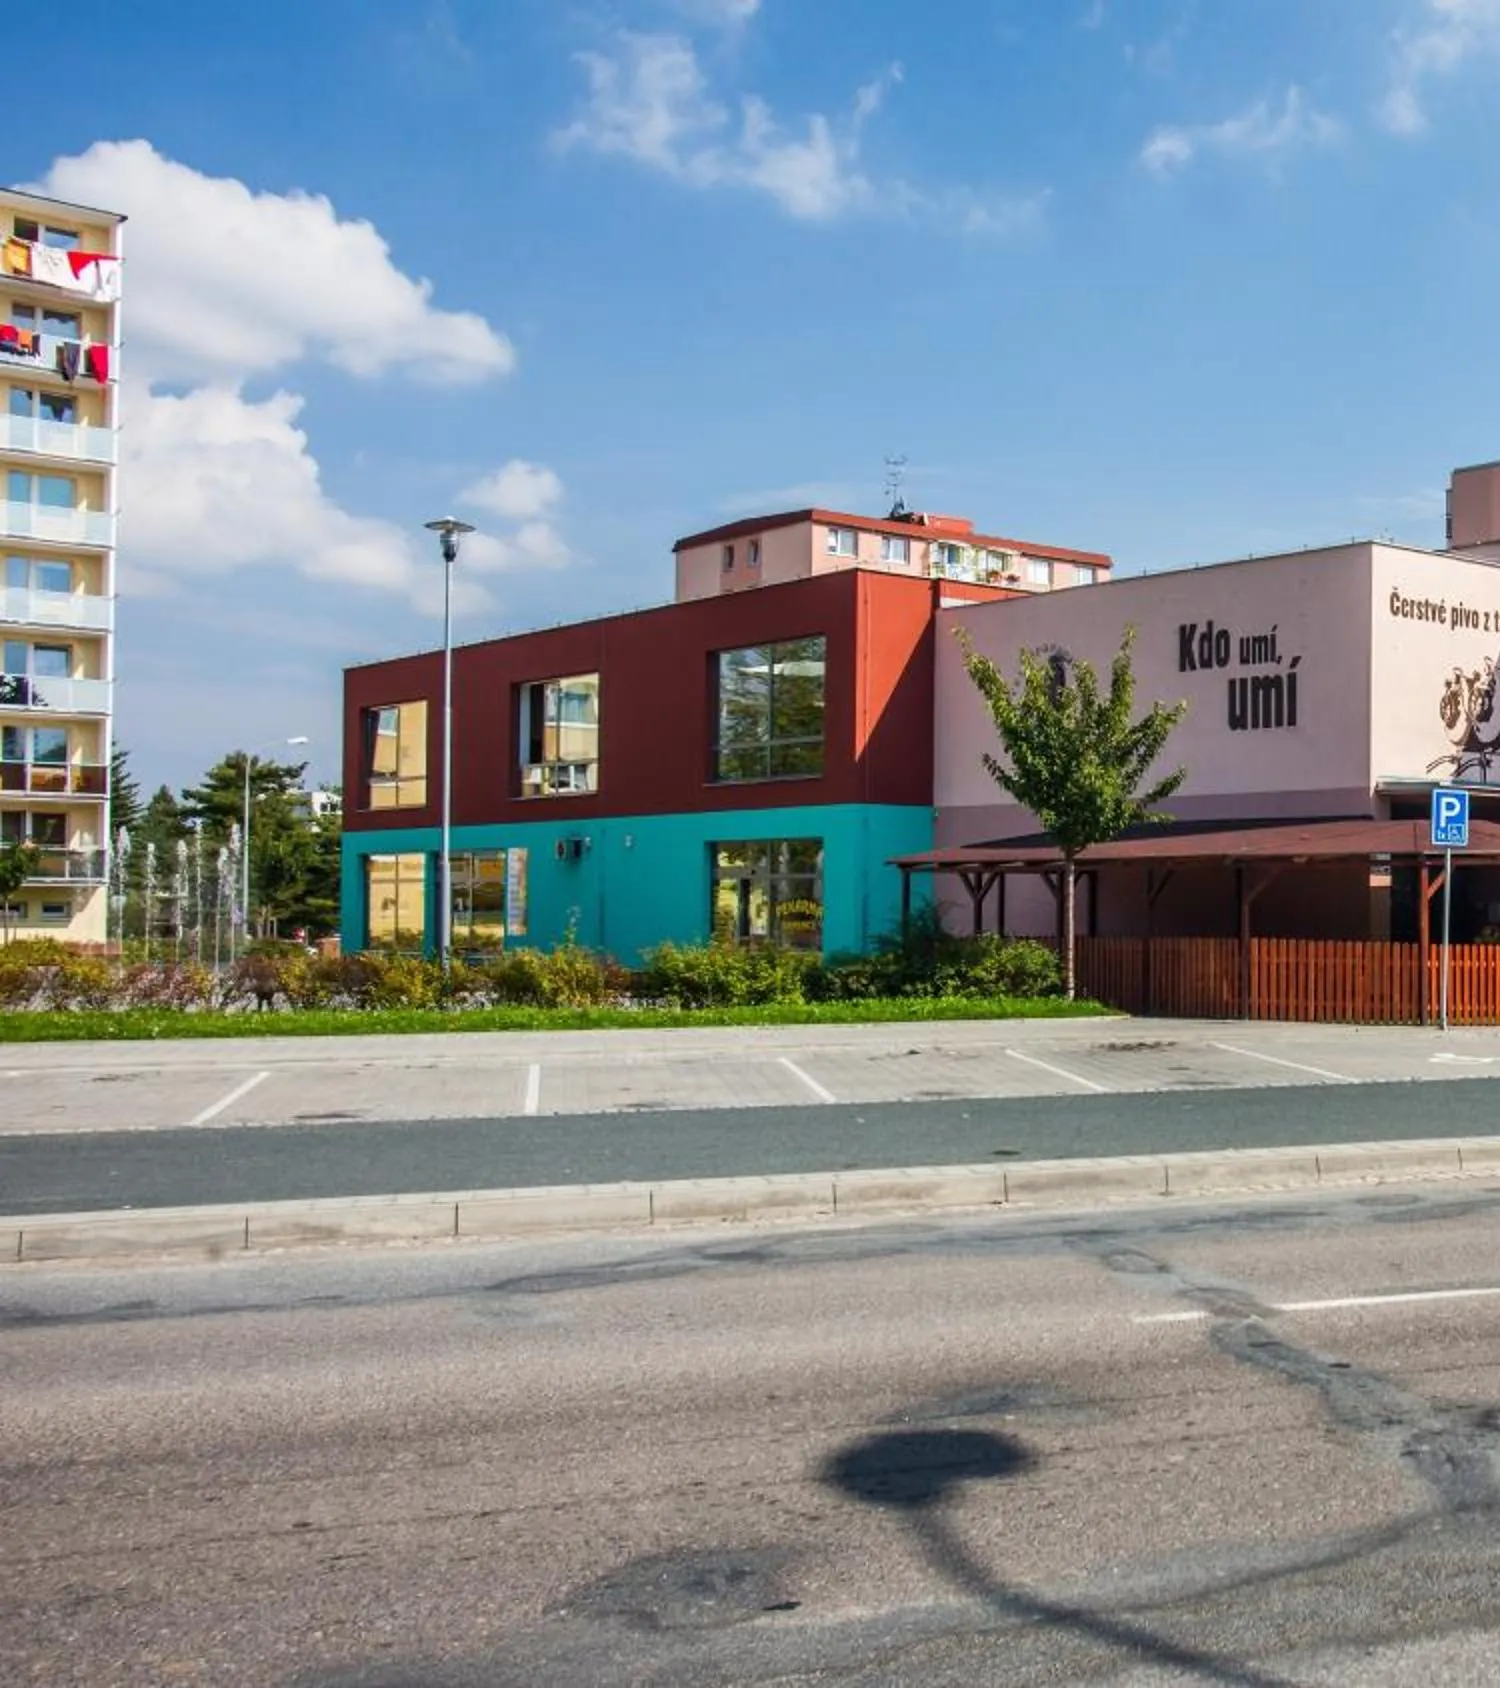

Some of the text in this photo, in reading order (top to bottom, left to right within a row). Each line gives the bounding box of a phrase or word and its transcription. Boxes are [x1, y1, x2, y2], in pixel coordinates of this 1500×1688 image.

[1390, 586, 1447, 625] Čerstvé
[1451, 602, 1479, 631] pivo
[1483, 611, 1490, 632] z
[1179, 620, 1283, 672] Kdo umí,
[1228, 656, 1302, 731] umí
[1440, 797, 1461, 828] P
